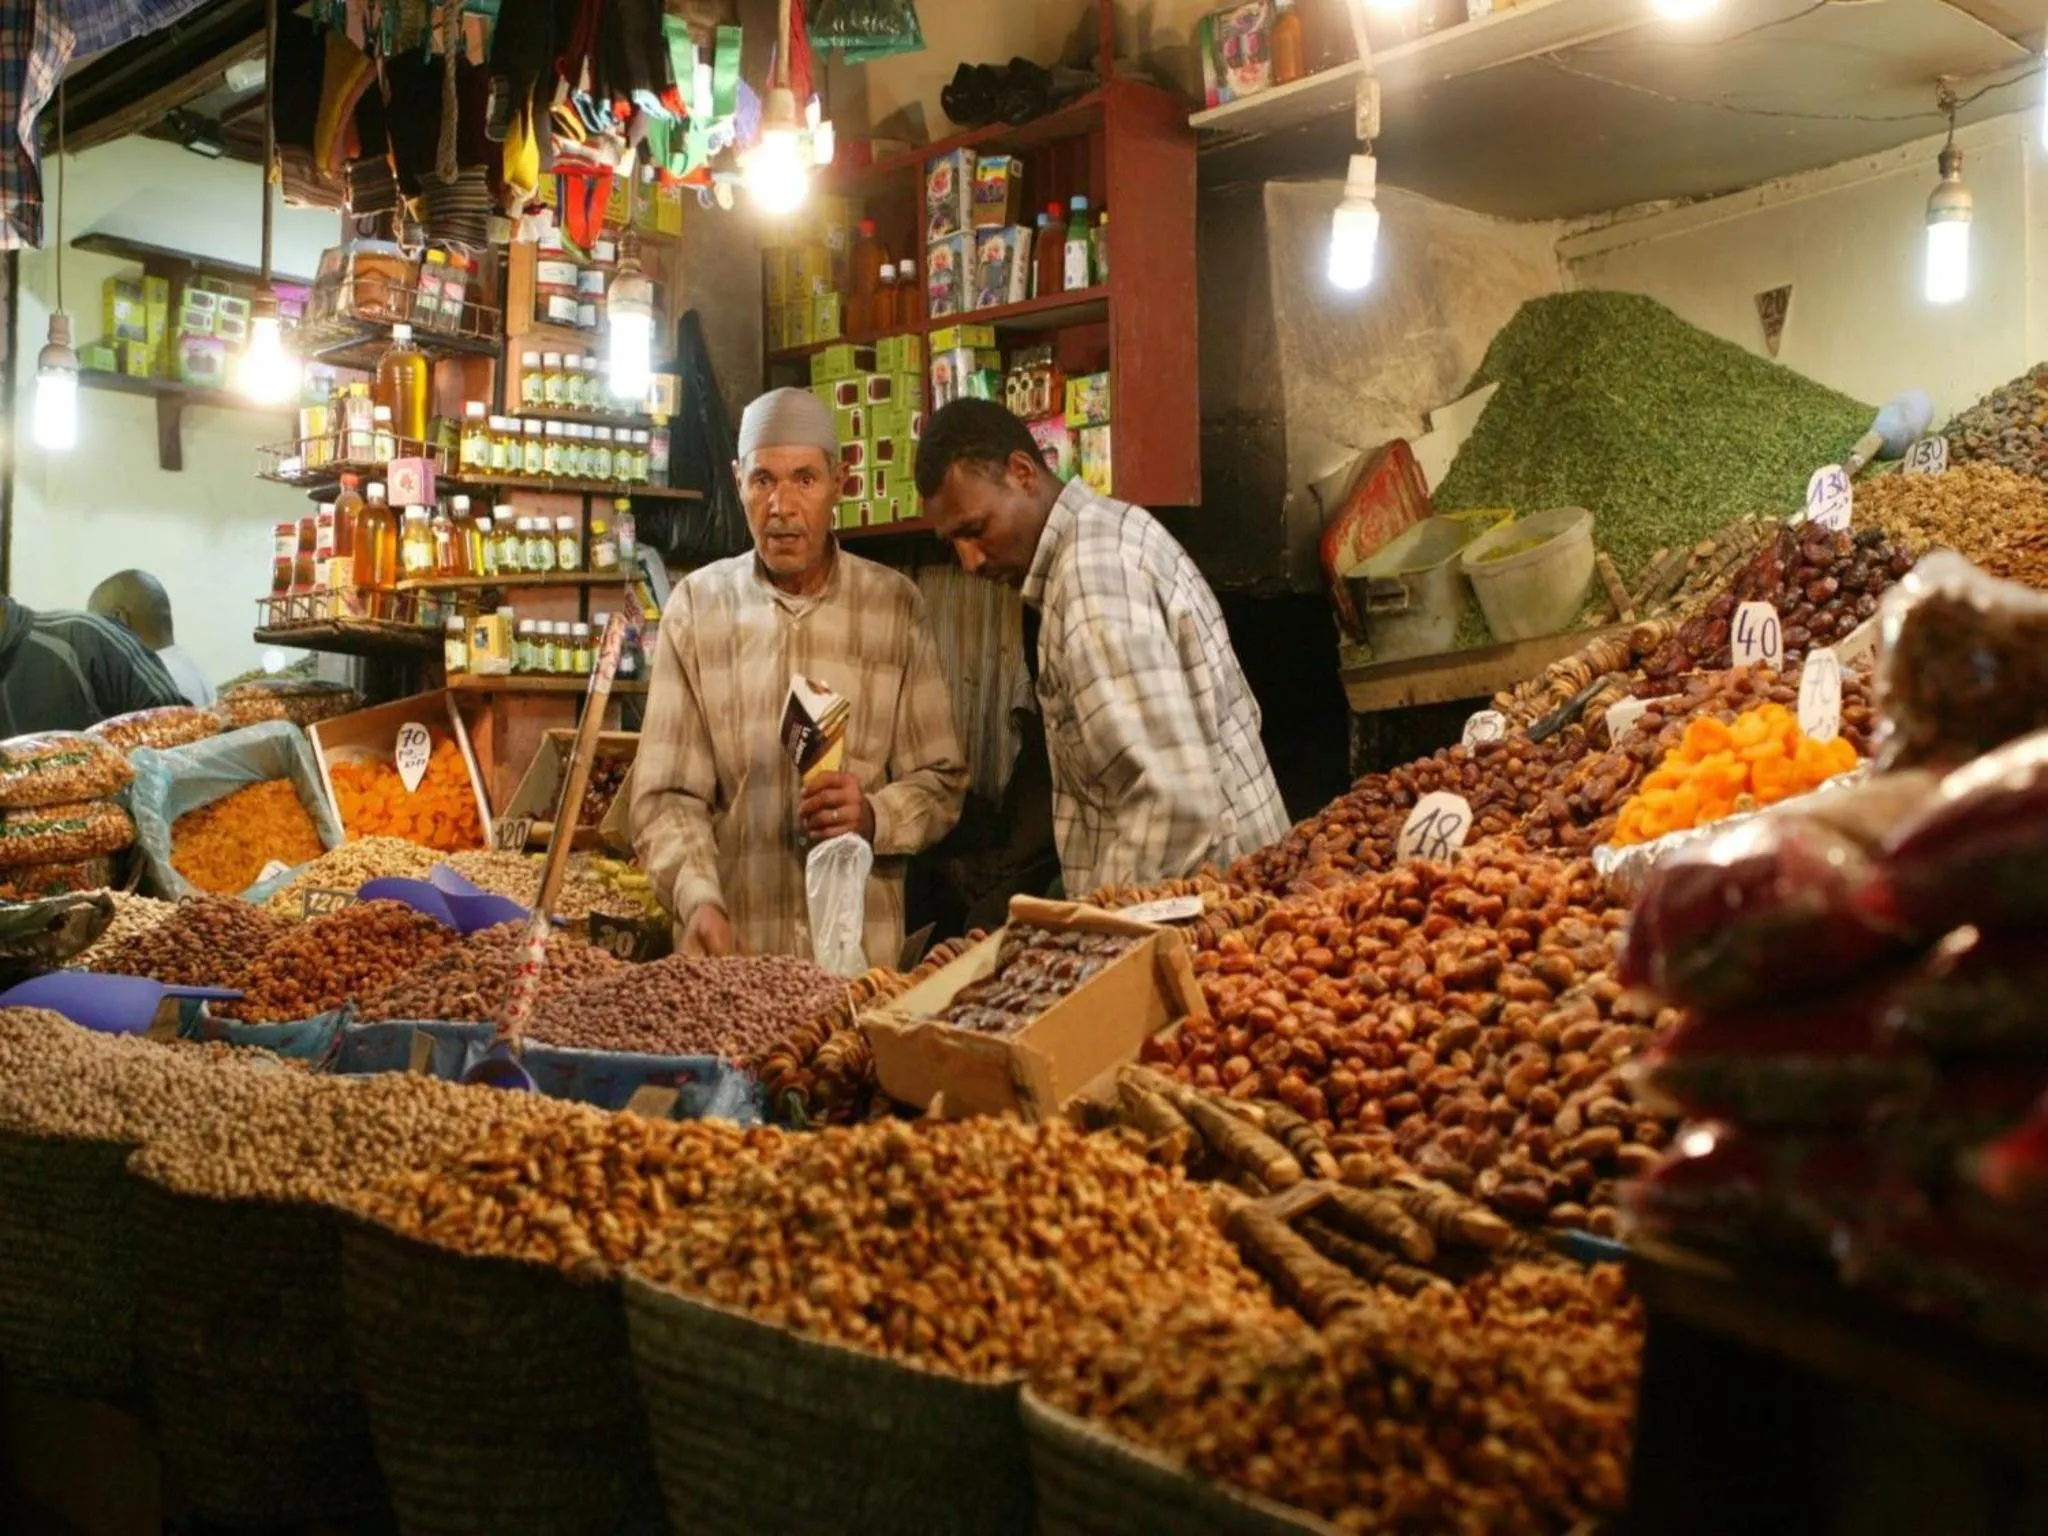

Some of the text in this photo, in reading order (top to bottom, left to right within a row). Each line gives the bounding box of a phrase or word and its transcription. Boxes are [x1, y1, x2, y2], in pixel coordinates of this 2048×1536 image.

[1912, 438, 1943, 468] 130
[1737, 608, 1778, 659] 40
[1806, 657, 1839, 708] 70
[400, 727, 427, 749] 70
[494, 820, 527, 851] 120
[1406, 806, 1463, 861] 18
[308, 891, 346, 914] 120
